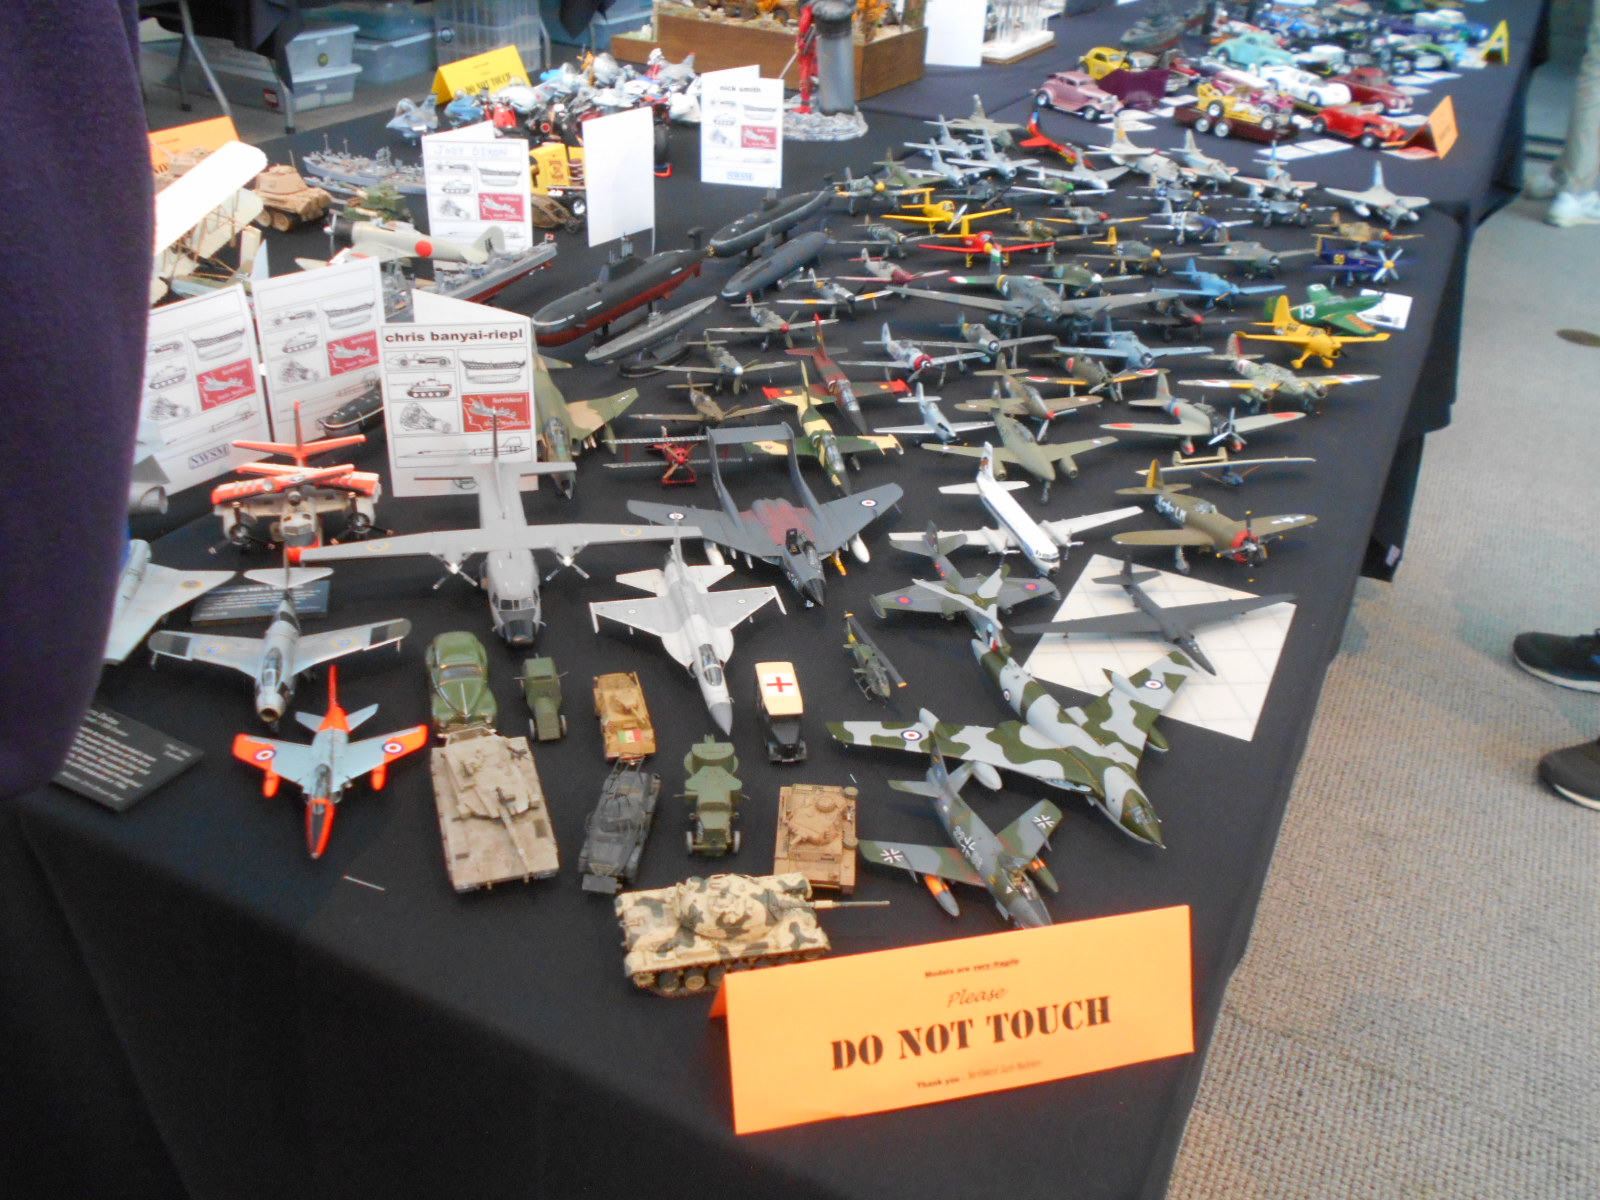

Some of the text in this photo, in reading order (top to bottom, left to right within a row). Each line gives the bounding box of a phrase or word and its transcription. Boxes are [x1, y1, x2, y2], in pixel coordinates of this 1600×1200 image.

[1299, 303, 1317, 320] 13
[384, 328, 524, 343] chris banyai-riepl
[924, 958, 1020, 979] Models are very fragile
[946, 987, 1008, 1009] Please
[831, 995, 1112, 1071] DO NOT TOUCH
[916, 1077, 960, 1089] Thank you
